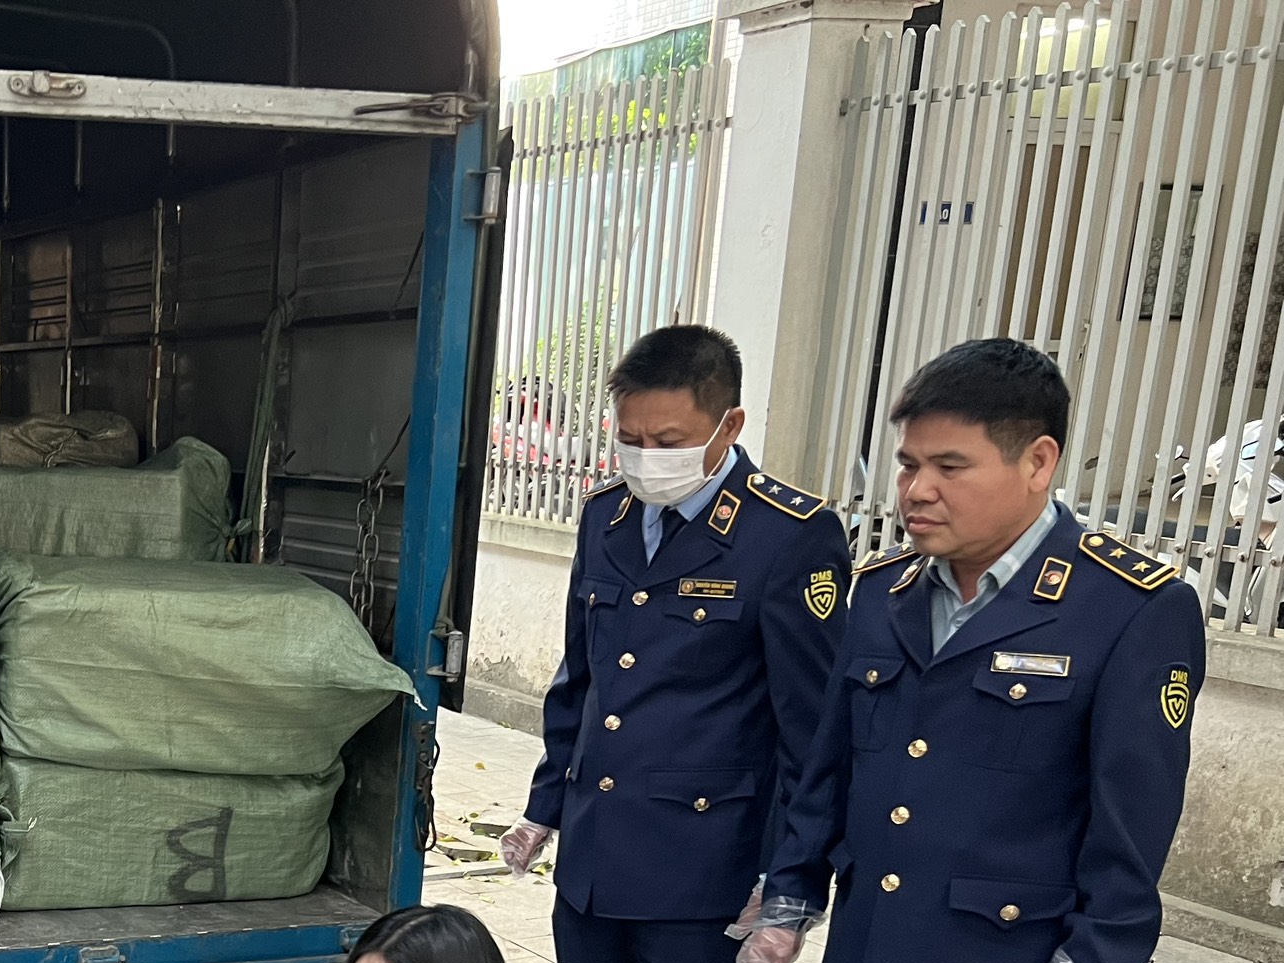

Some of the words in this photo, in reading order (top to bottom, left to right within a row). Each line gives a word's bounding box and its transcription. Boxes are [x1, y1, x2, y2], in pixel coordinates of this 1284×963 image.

[810, 570, 833, 583] DMS
[1170, 670, 1188, 685] DMS
[166, 806, 234, 904] B
